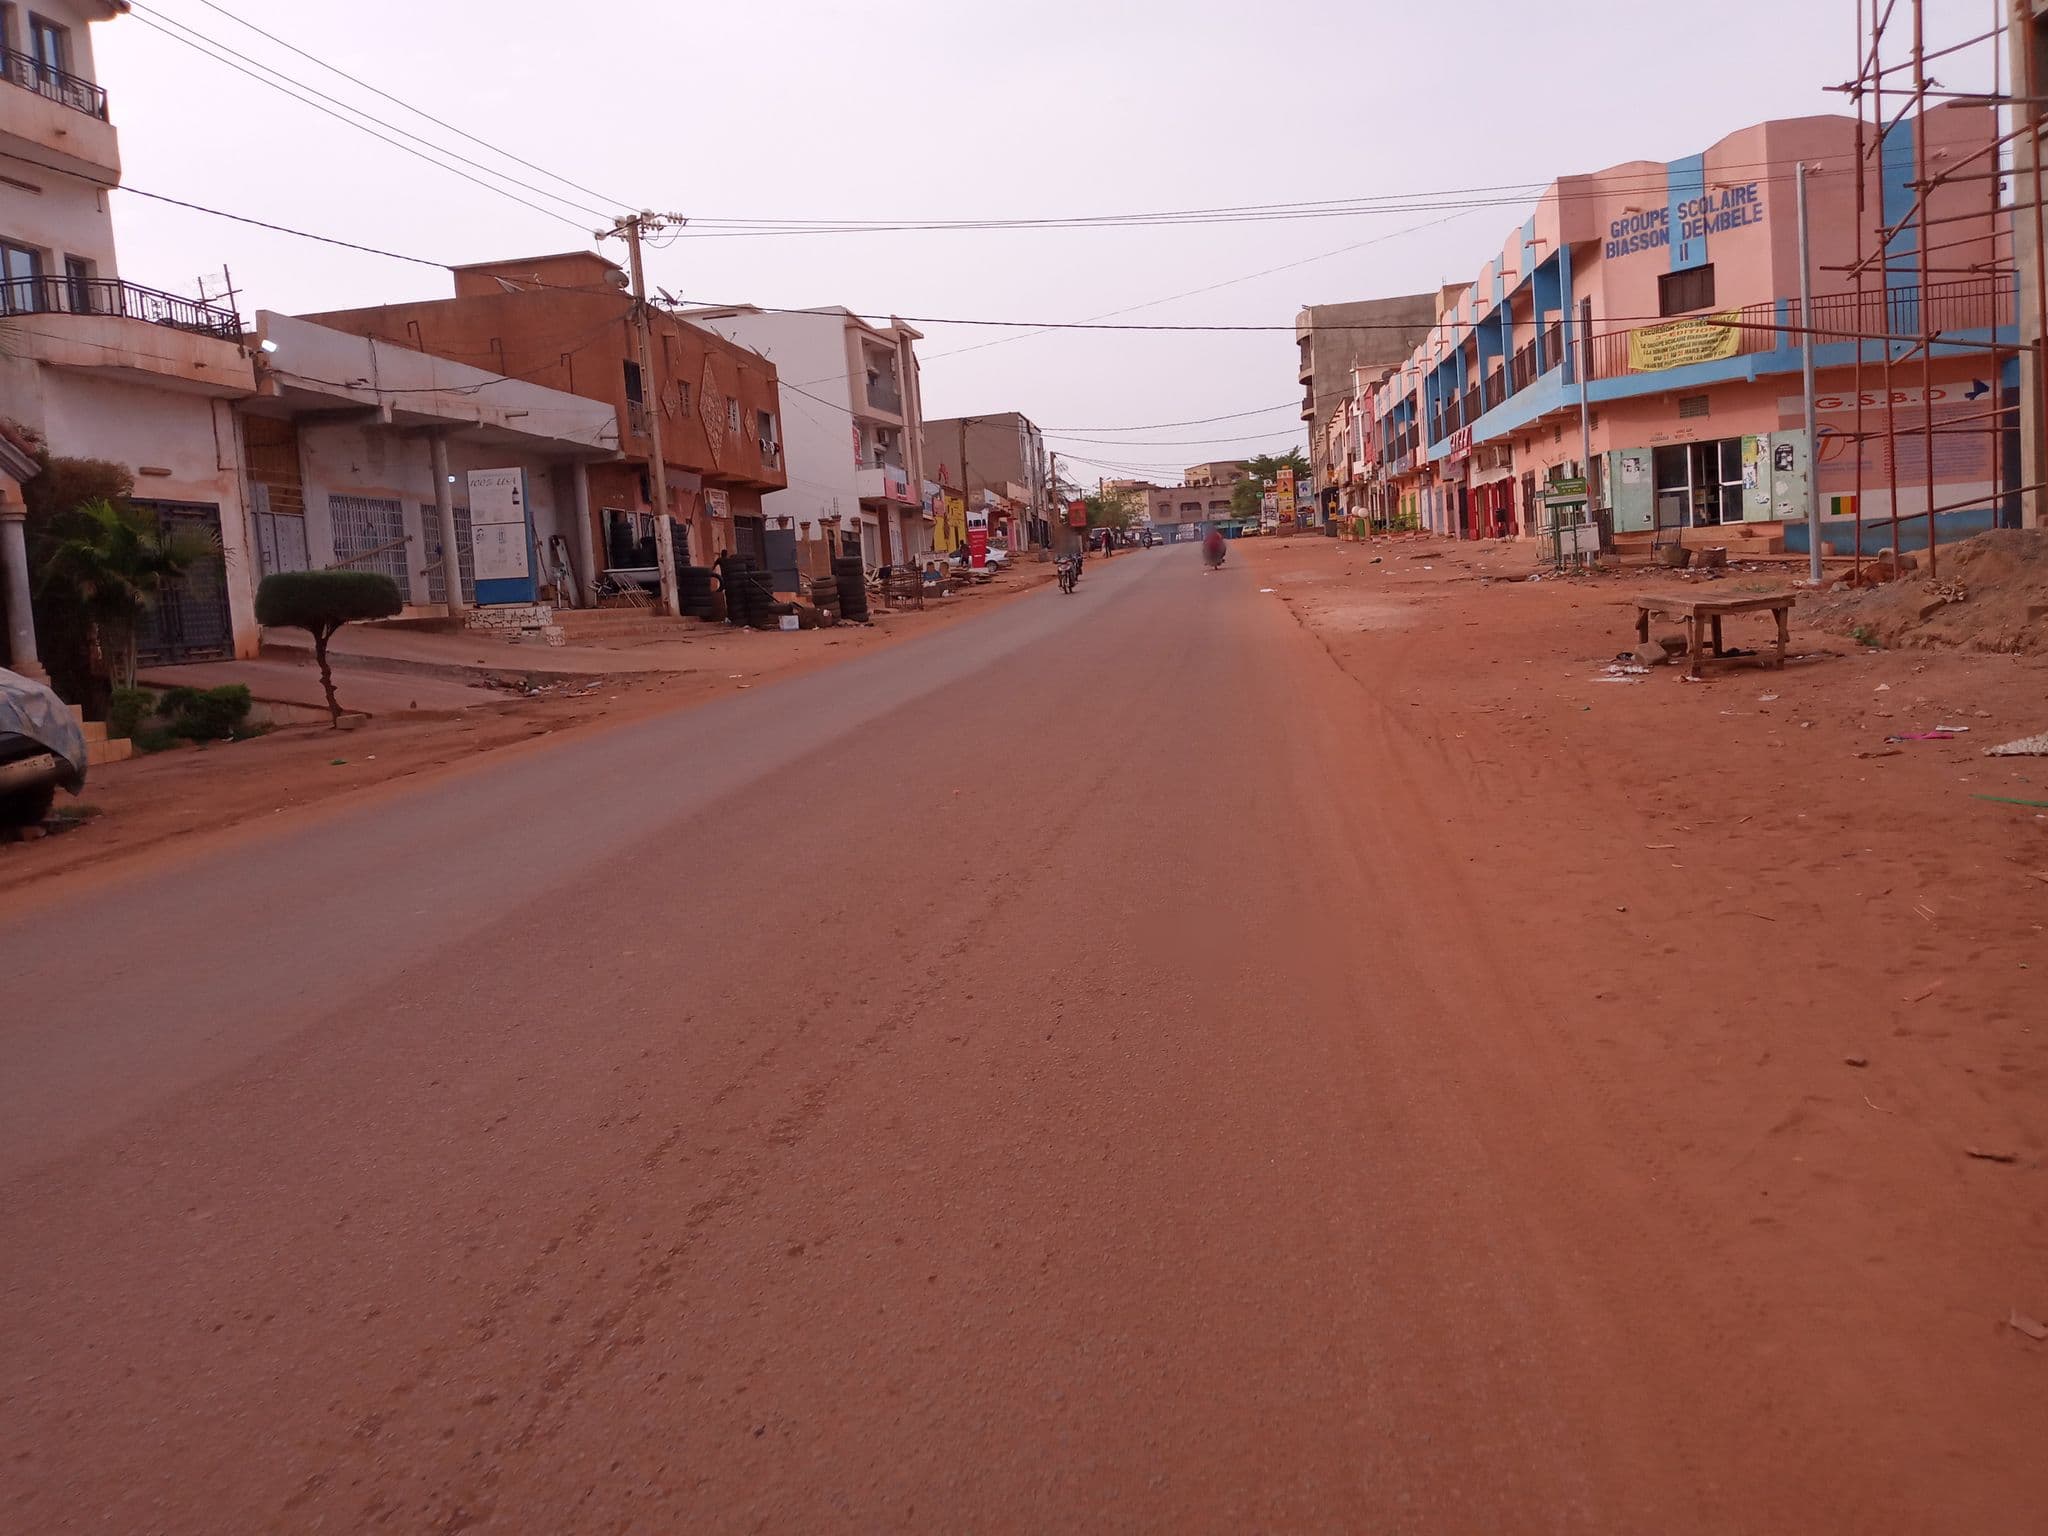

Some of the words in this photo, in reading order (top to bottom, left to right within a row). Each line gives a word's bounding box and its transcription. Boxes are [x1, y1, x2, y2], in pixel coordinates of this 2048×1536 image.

[1611, 207, 1669, 238] GROUPE
[1677, 183, 1758, 220] SCOLAIRE
[1606, 227, 1670, 259] BIASSON
[1682, 202, 1763, 241] DEMBELE
[1679, 243, 1689, 262] II
[1640, 325, 1675, 337] EXCURSION
